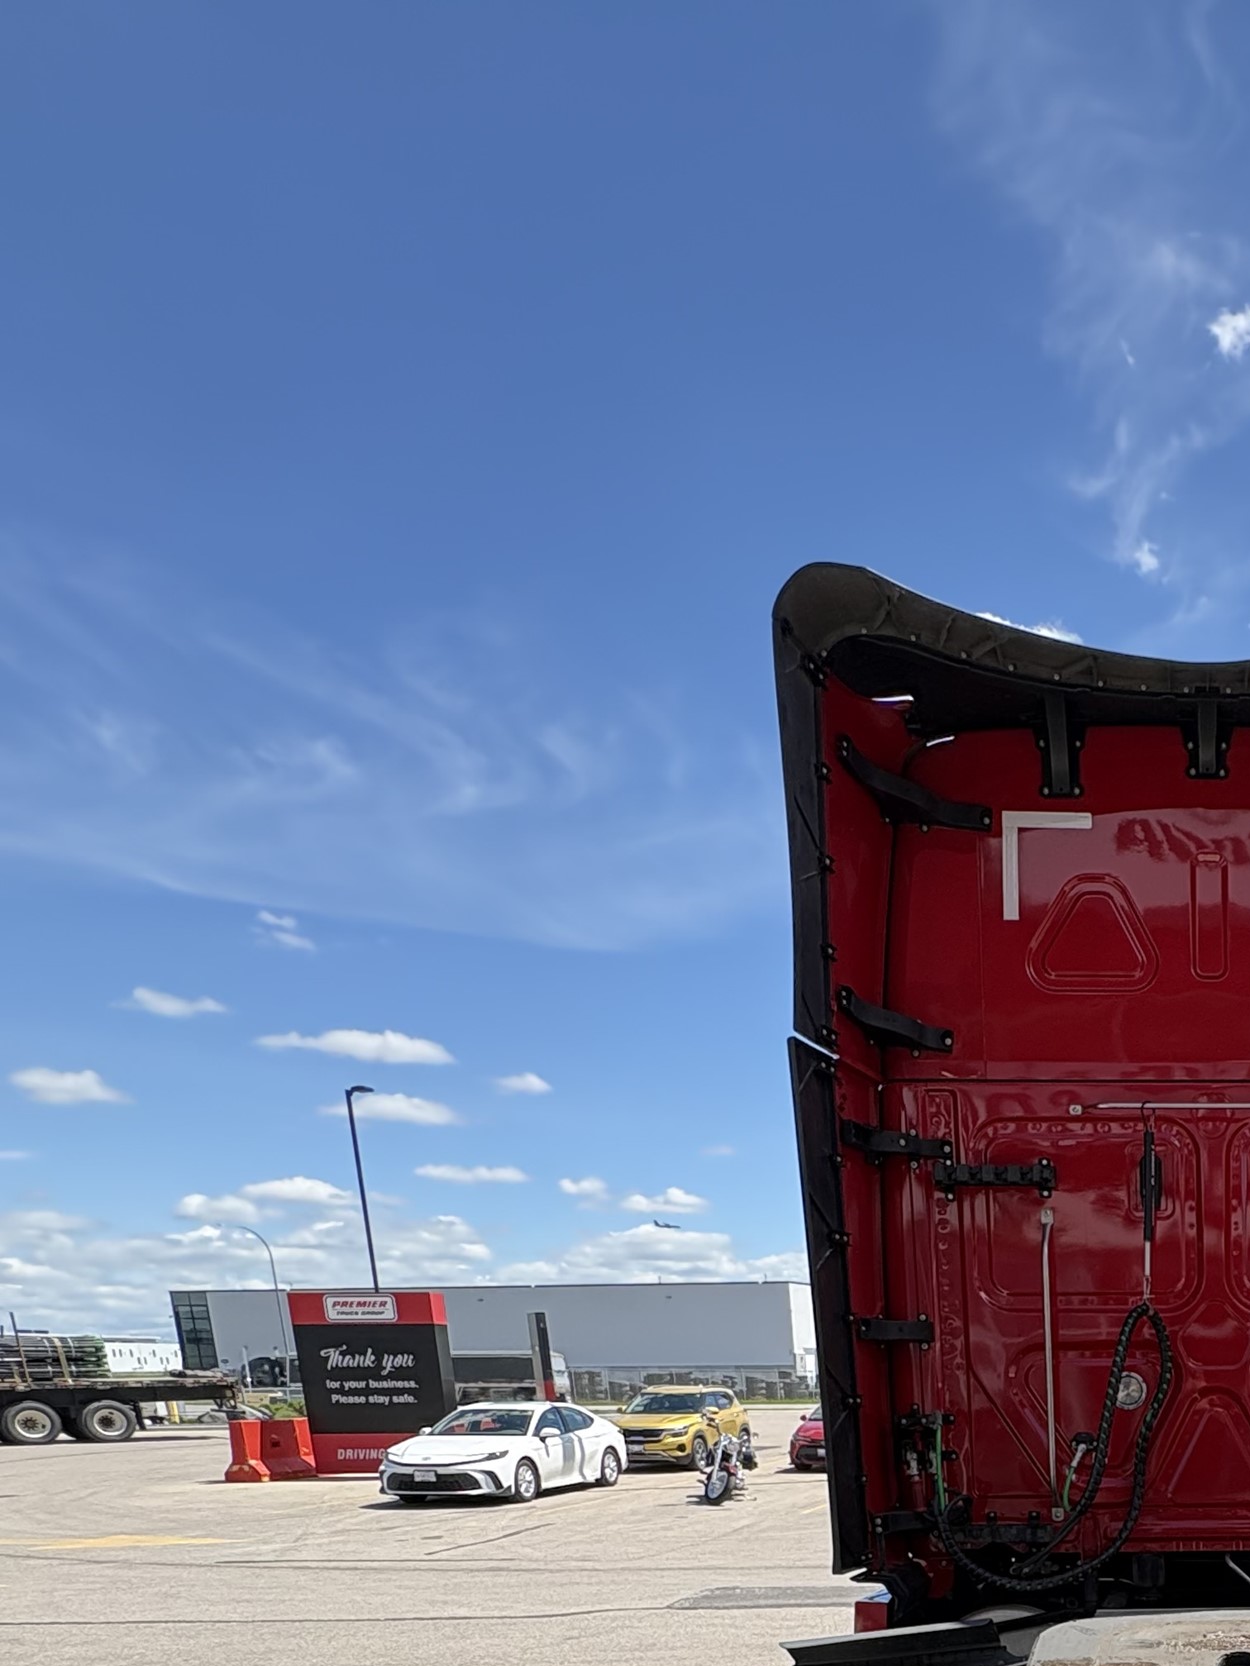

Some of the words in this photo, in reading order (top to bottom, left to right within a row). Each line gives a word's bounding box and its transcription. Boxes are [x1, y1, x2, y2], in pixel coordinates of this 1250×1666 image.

[331, 1300, 388, 1308] PREMIER
[320, 1344, 377, 1371] Thank
[381, 1353, 415, 1375] you
[325, 1379, 341, 1389] for
[343, 1380, 366, 1391] your
[368, 1379, 419, 1389] business.
[331, 1394, 366, 1404] Please
[368, 1394, 390, 1405] stay
[392, 1393, 418, 1403] safe.
